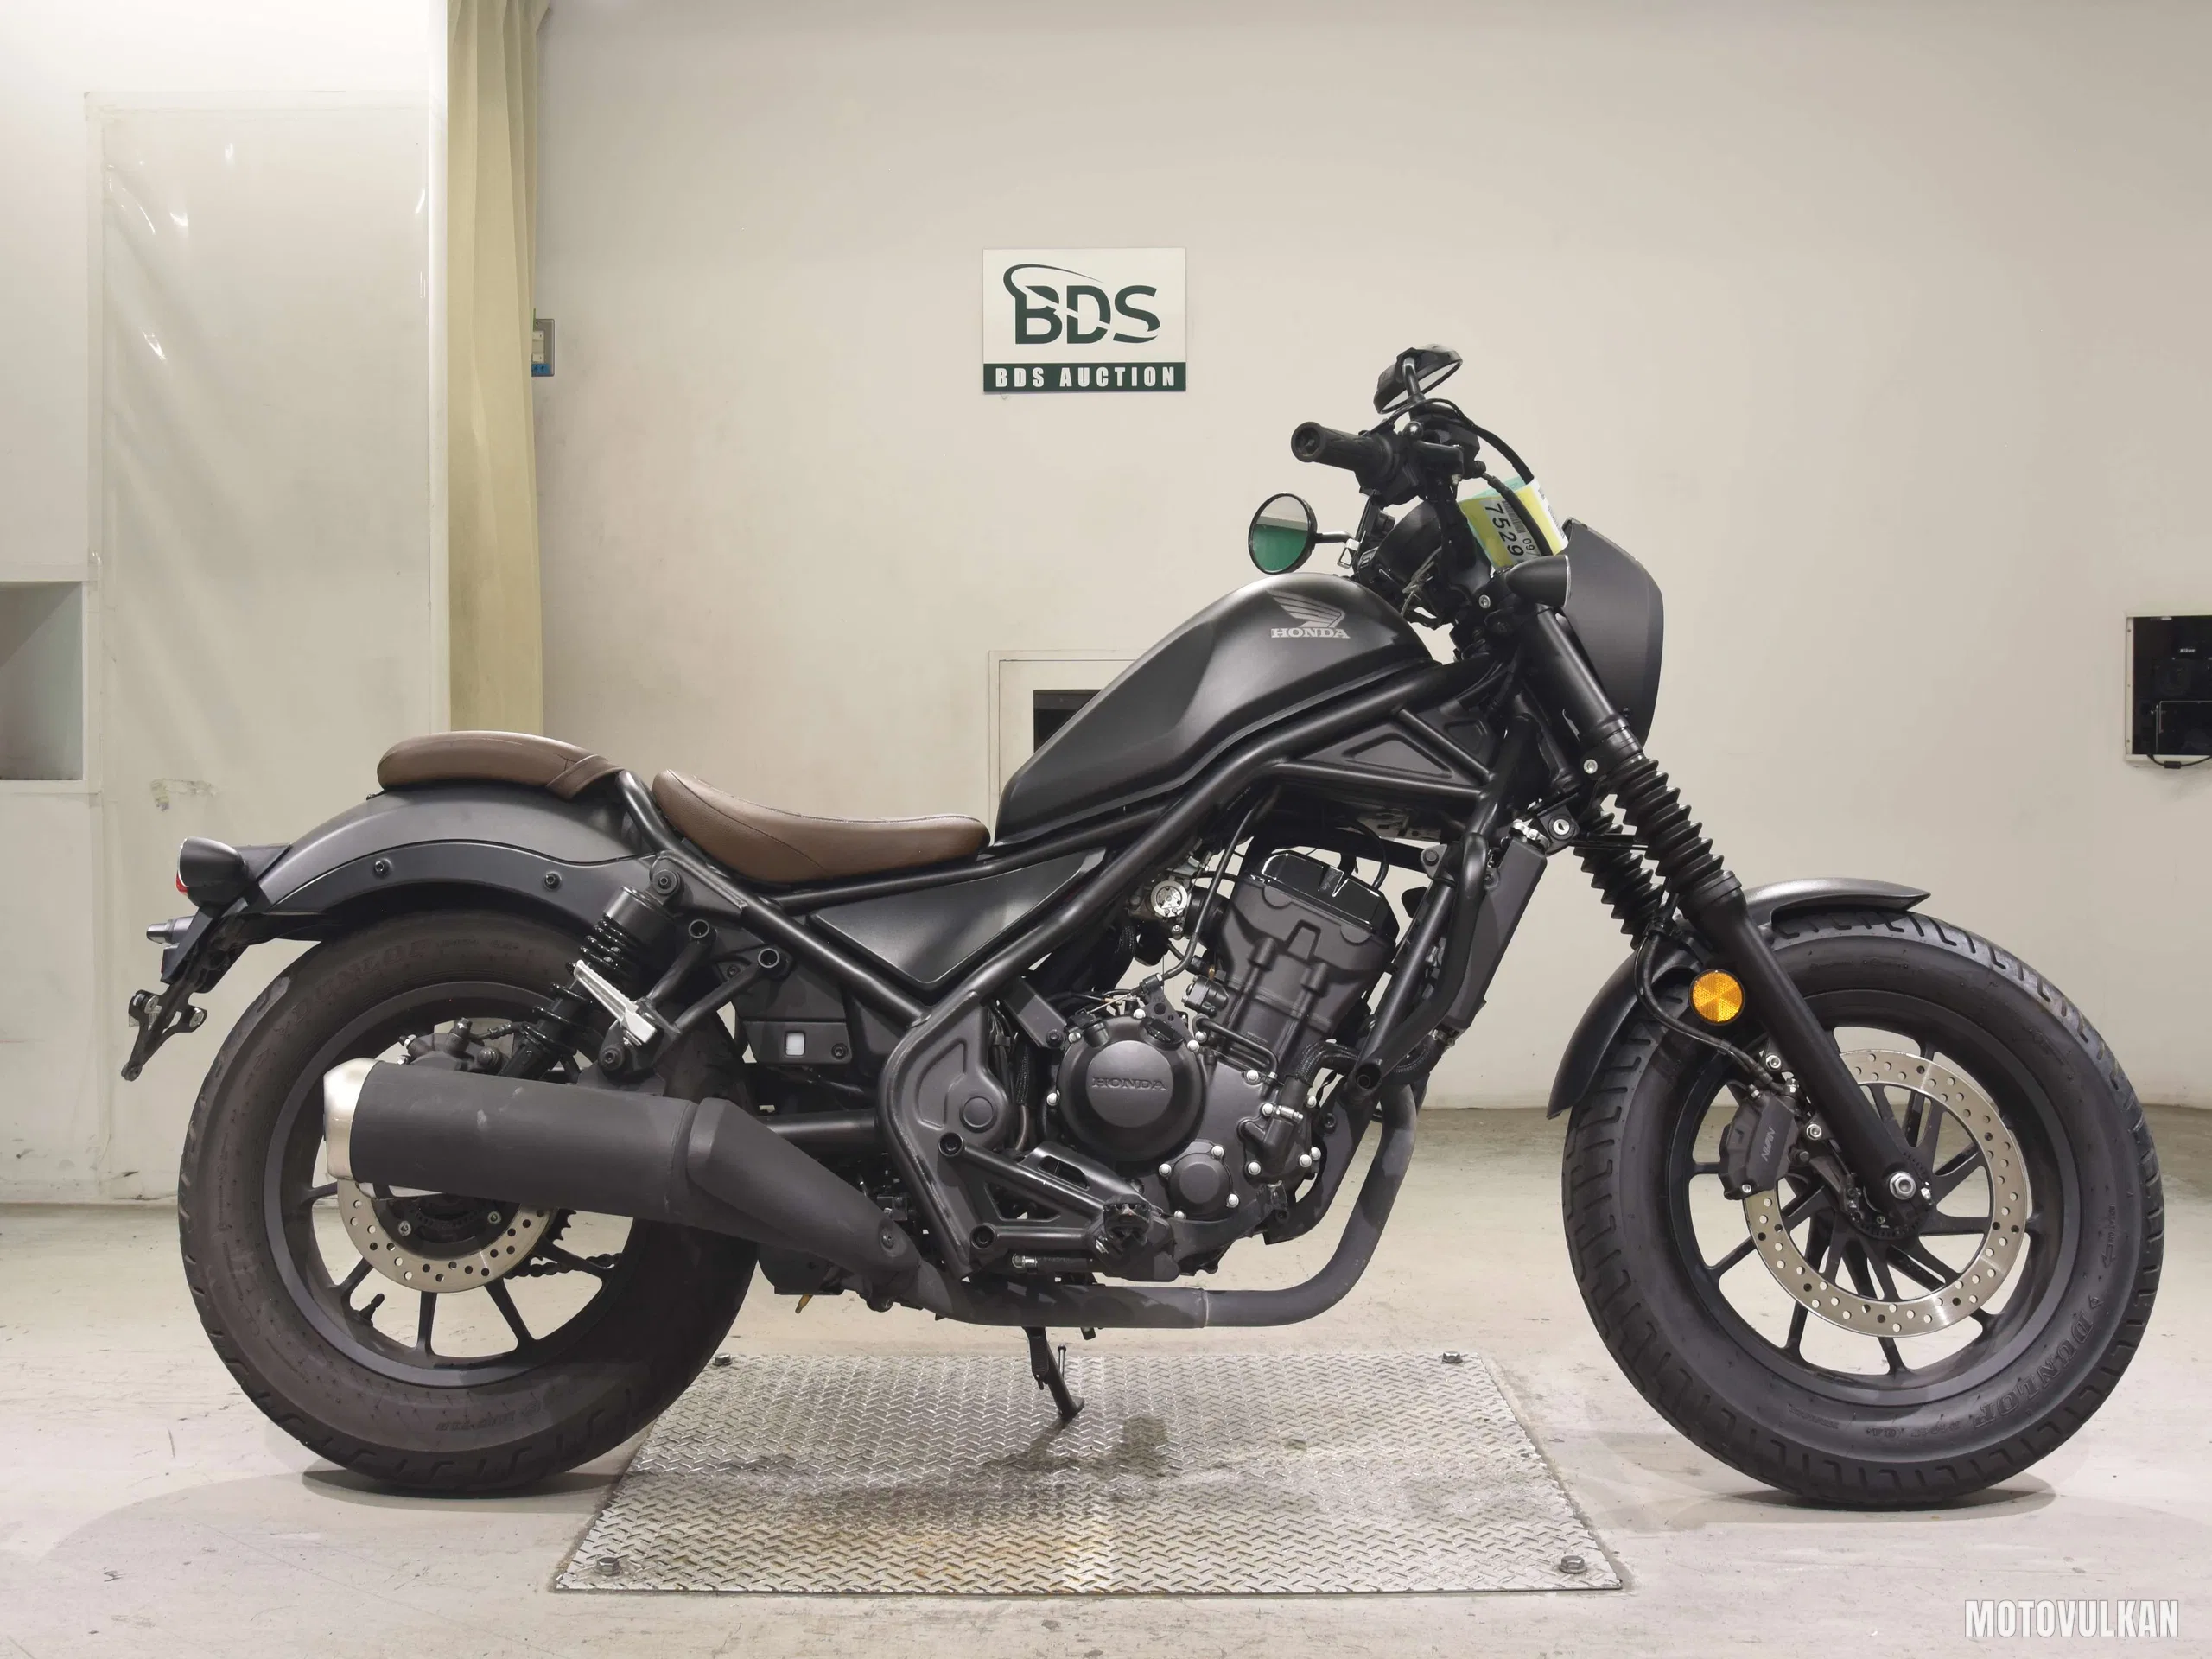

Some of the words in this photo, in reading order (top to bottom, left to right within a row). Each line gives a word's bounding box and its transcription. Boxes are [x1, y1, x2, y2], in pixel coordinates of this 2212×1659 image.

[1003, 264, 1160, 344] BDS
[995, 367, 1045, 387] BDS
[1059, 366, 1174, 387] AUCTION
[1485, 503, 1524, 556] 7529
[1271, 628, 1351, 639] HONDA
[1092, 1077, 1167, 1090] HONDA
[1974, 1313, 2094, 1428] DUNLOP
